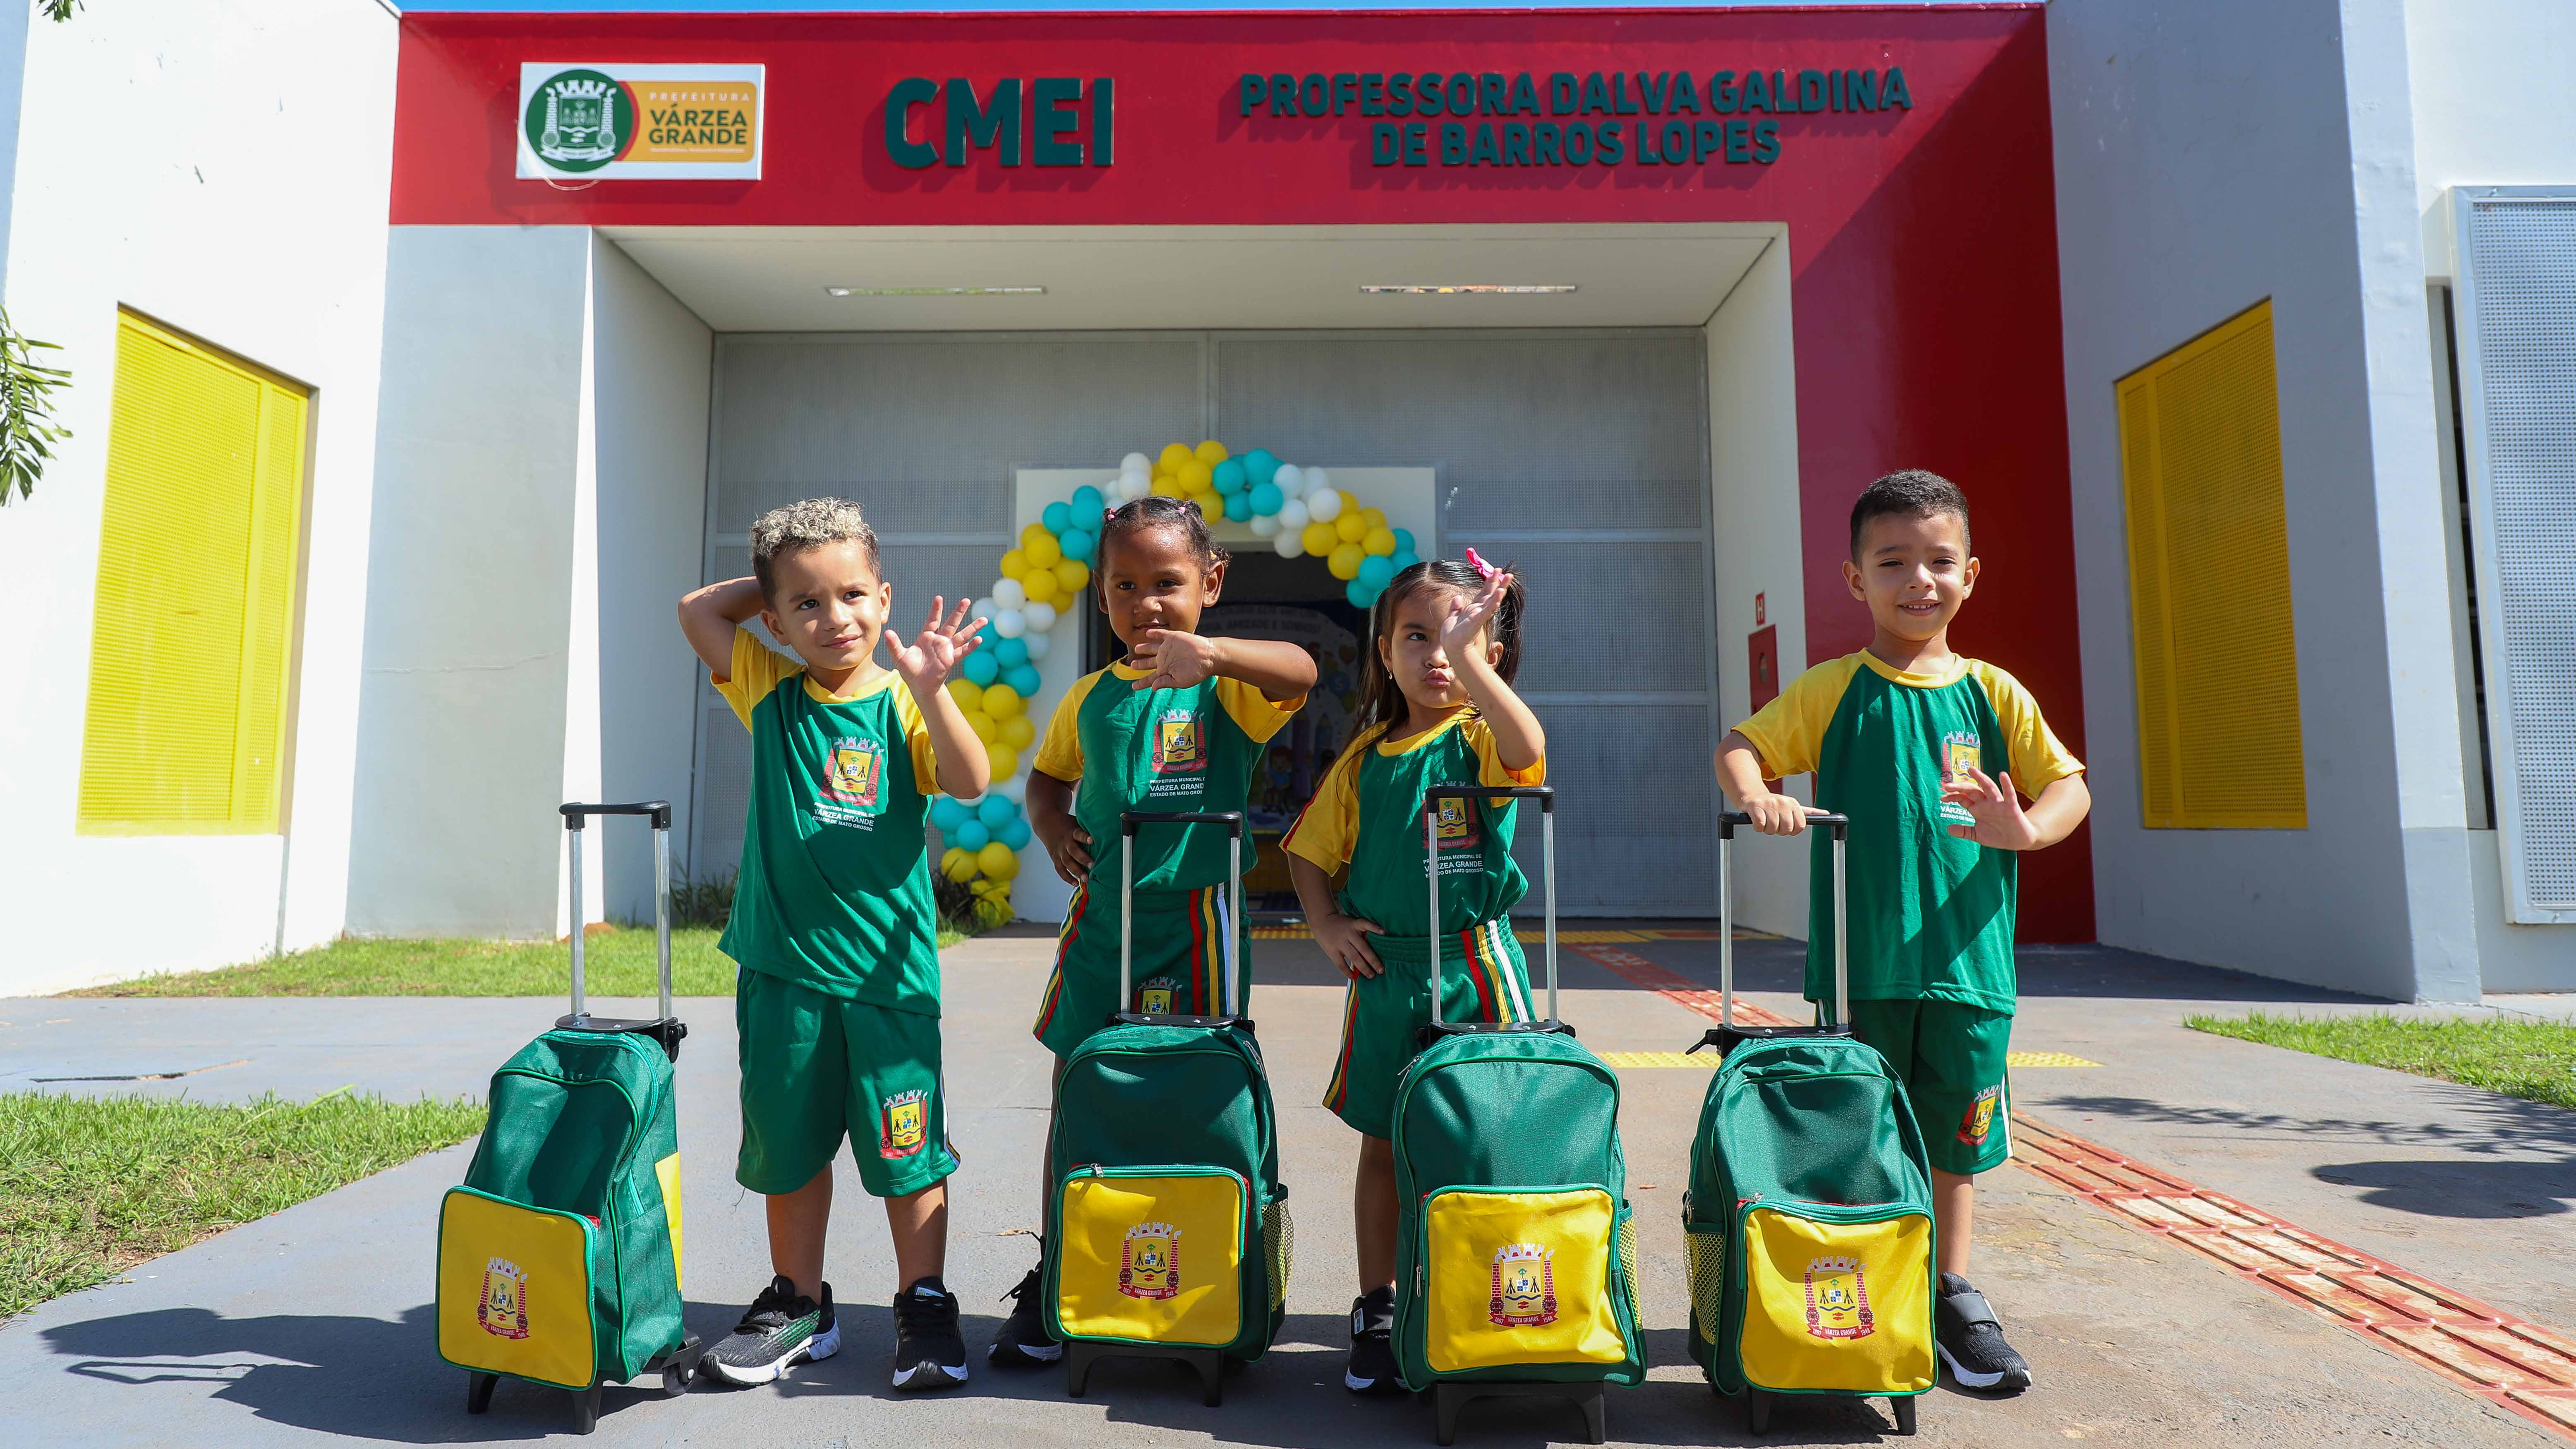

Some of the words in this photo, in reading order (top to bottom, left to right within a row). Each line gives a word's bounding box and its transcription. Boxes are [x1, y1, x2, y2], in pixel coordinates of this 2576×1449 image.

[649, 92, 750, 102] PREFEITURA
[1242, 72, 1540, 117] PROFESSORA
[1551, 71, 1701, 115] DALVA
[1711, 68, 1912, 113] GALDINA
[650, 104, 747, 127] VÁRZEA
[884, 77, 1115, 169] CMEI
[649, 129, 747, 145] GRANDE
[1372, 123, 1427, 165] DE
[1441, 122, 1625, 165] BARROS
[1637, 119, 1781, 164] LOPES
[814, 802, 842, 812] PREFEITURA
[843, 807, 867, 817] MUNICIPAL
[814, 808, 841, 820] VÁRZEA
[843, 814, 874, 826] GRANDE
[1940, 805, 1967, 816] VÁRZEA
